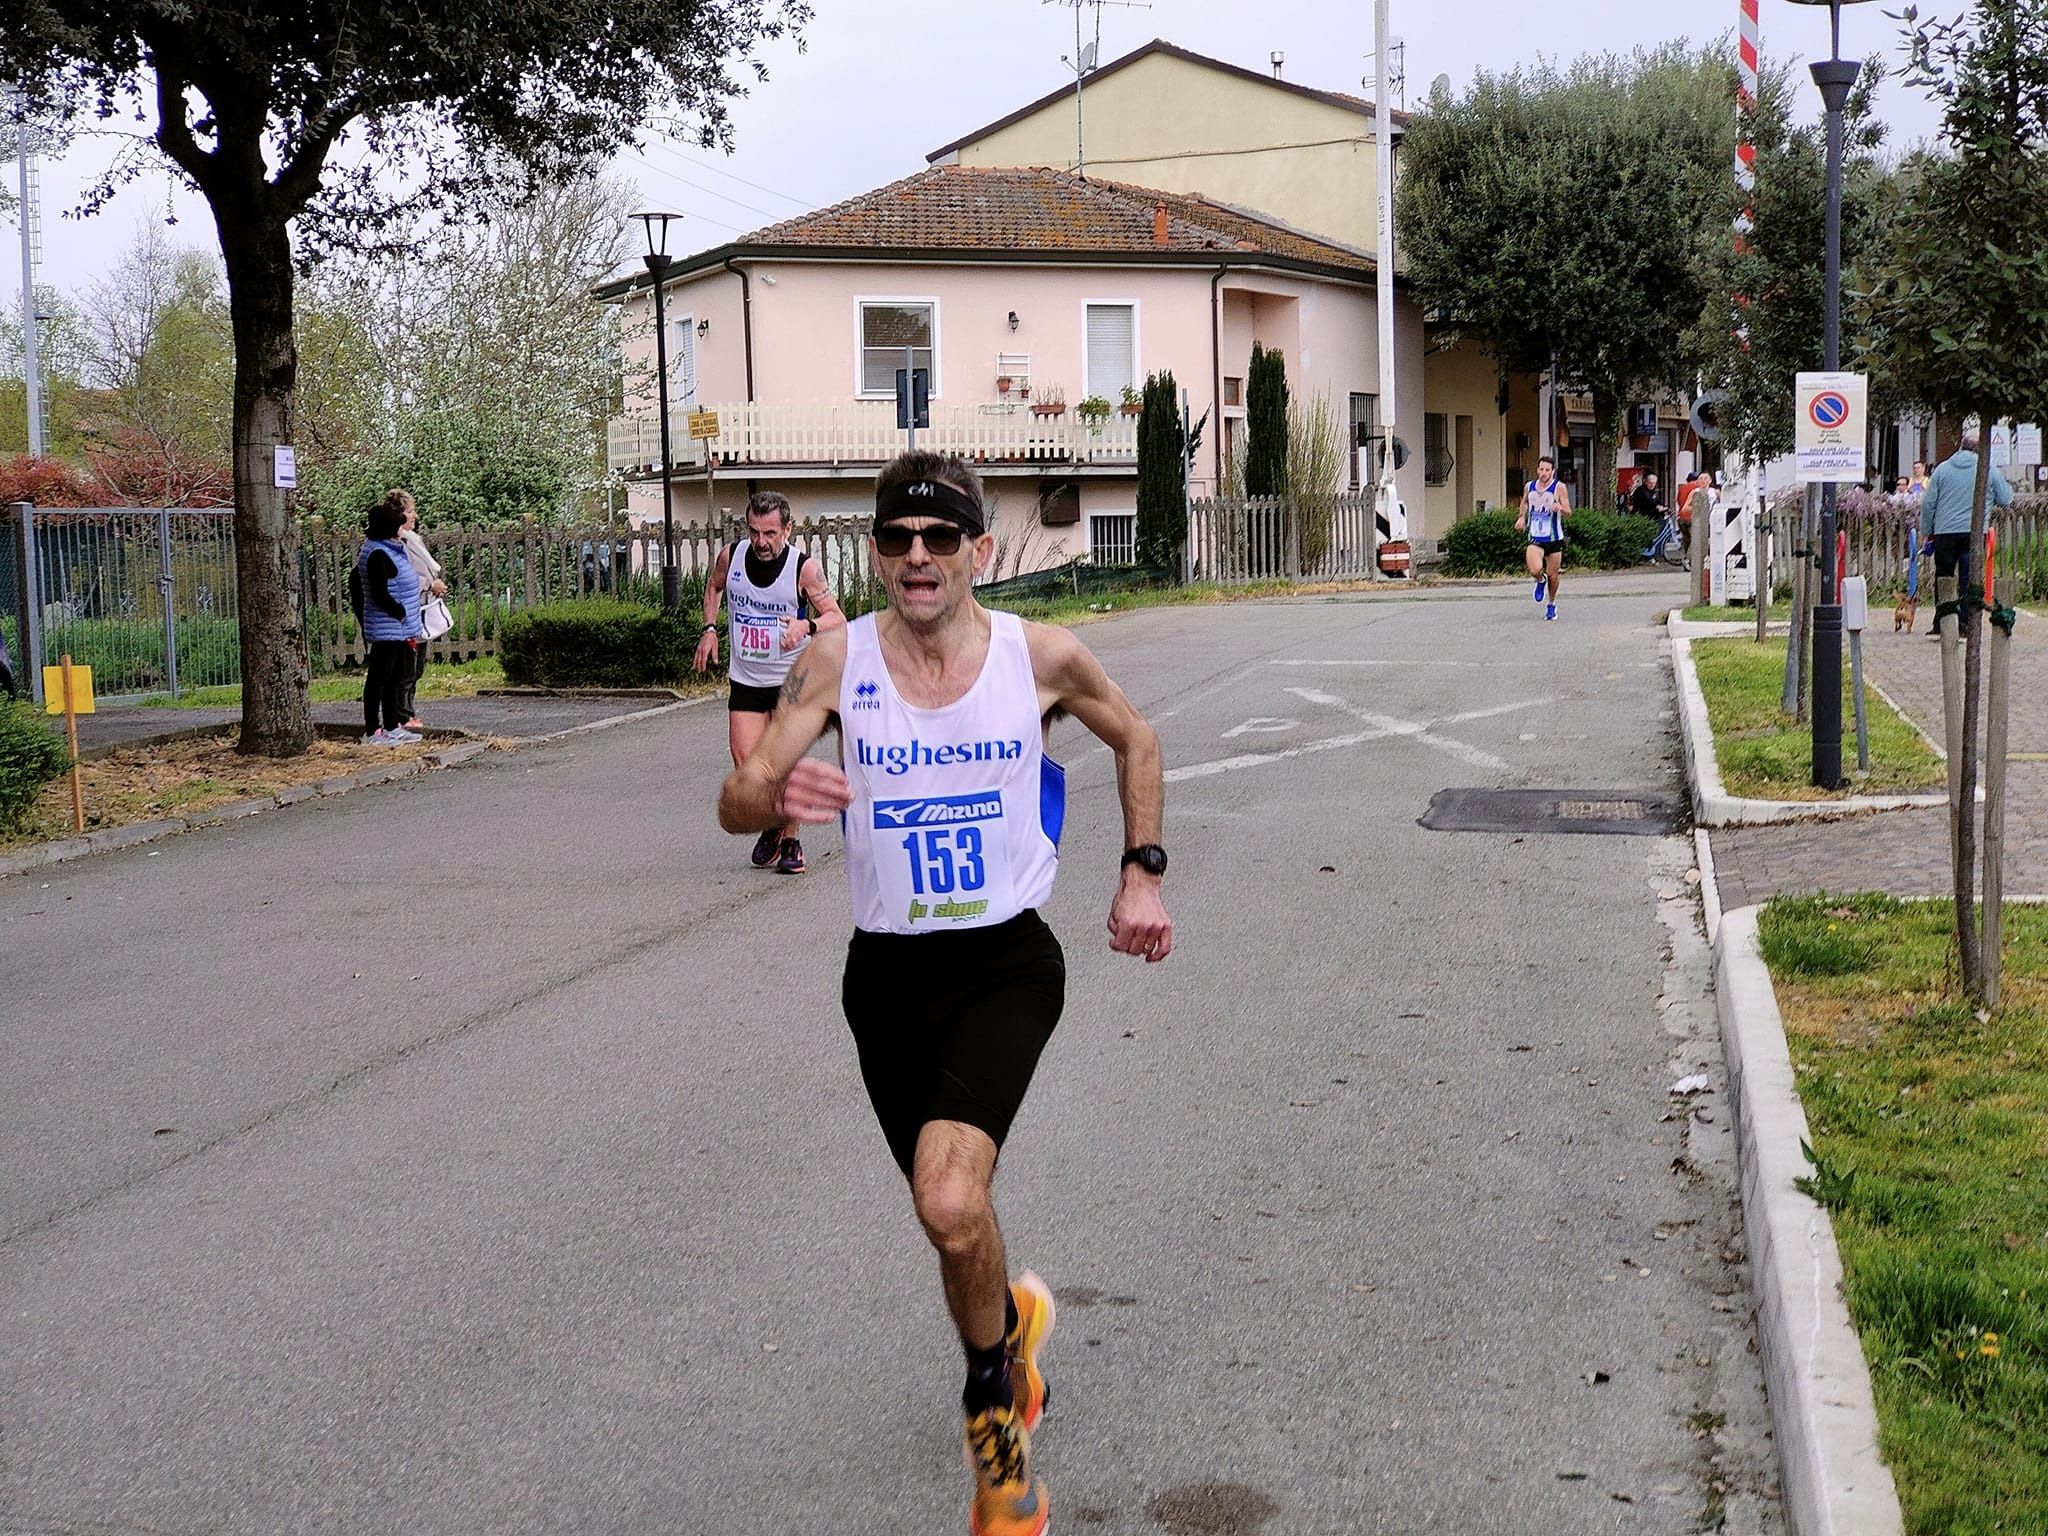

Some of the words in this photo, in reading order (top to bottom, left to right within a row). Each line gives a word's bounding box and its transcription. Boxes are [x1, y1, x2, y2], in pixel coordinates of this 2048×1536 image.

[730, 590, 787, 613] lughesina
[741, 625, 770, 650] 285
[857, 737, 1022, 775] lughesina
[903, 827, 985, 894] 153
